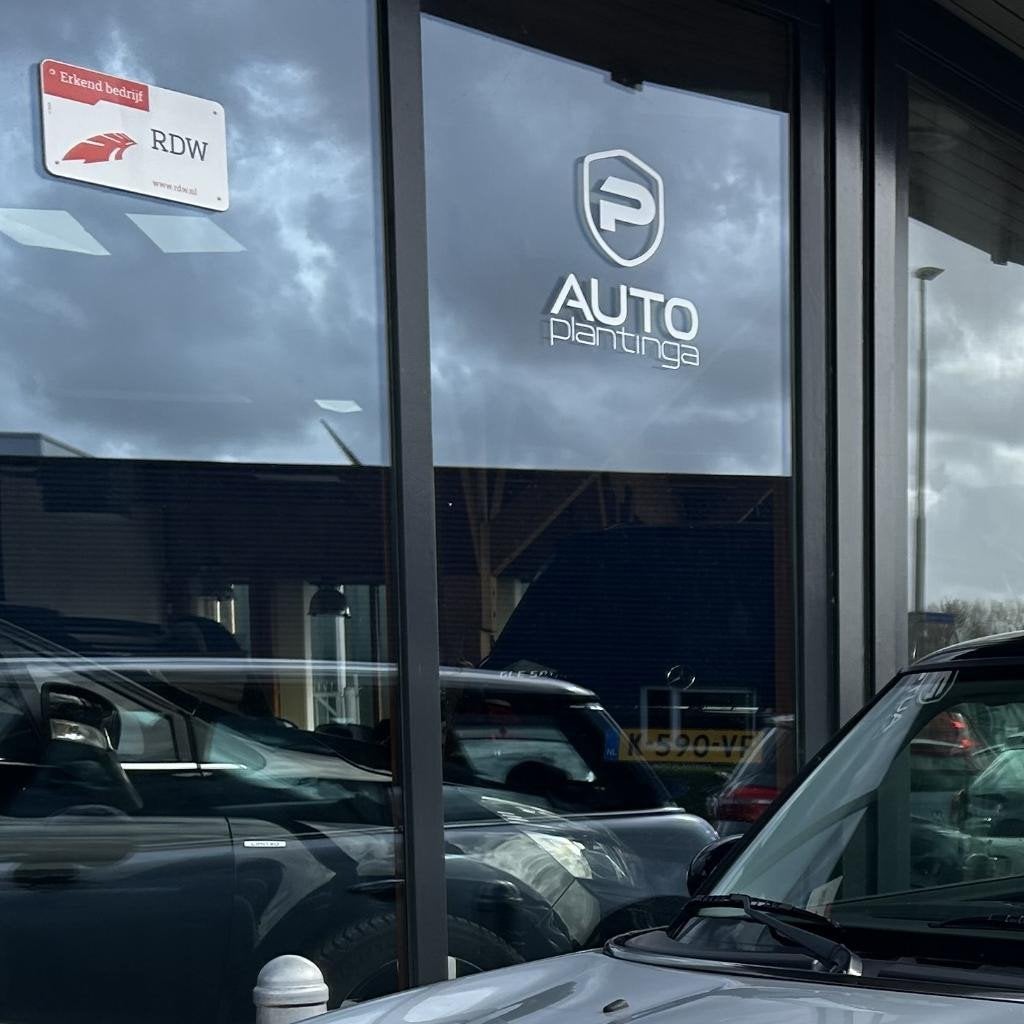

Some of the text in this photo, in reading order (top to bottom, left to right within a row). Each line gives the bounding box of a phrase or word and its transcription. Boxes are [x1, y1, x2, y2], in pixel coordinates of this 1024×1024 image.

[60, 71, 144, 103] Erkend bedrijf
[150, 128, 209, 162] RDW
[152, 179, 198, 197] www.rdw.nl
[550, 273, 699, 341] AUTO
[550, 316, 700, 370] plantinga
